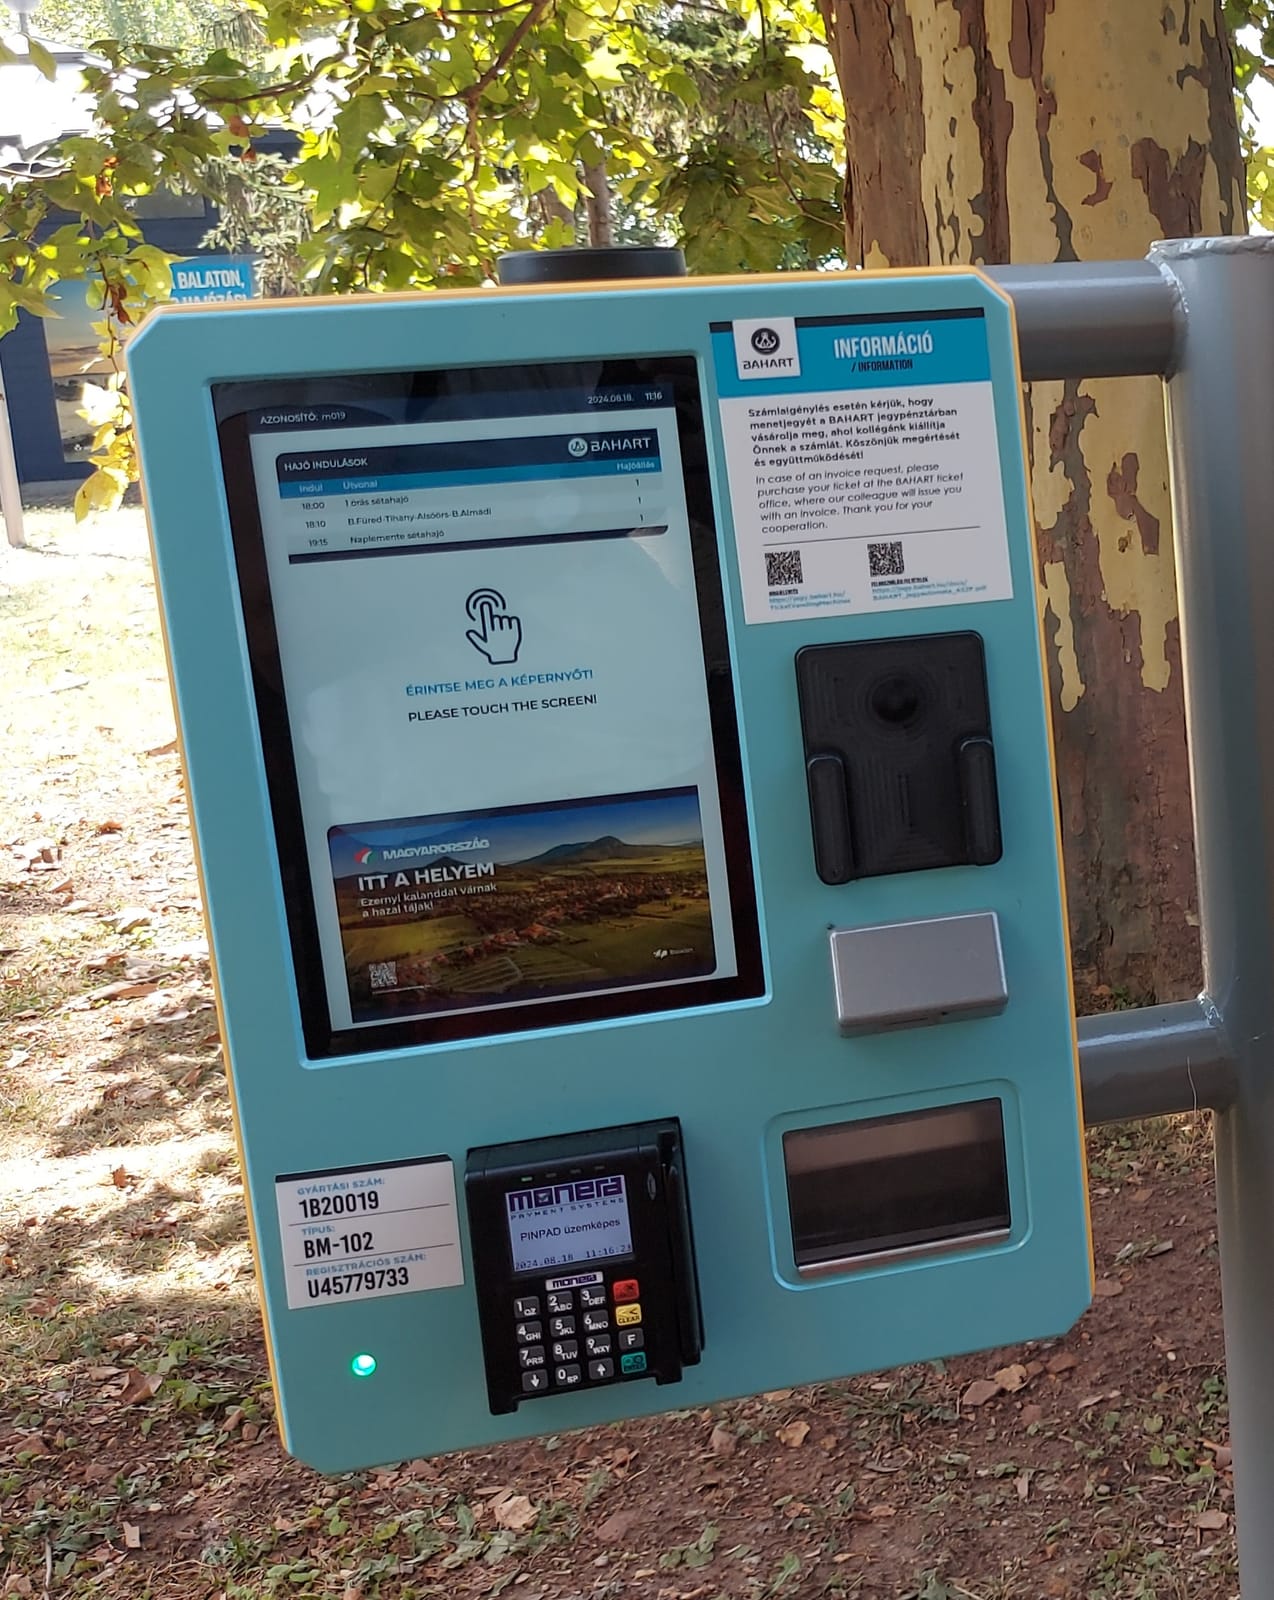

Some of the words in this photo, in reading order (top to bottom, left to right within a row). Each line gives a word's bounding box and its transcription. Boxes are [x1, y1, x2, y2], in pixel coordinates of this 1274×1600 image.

[178, 269, 245, 289] BALATON,
[834, 330, 934, 360] INFORMÁCIÓ
[743, 358, 794, 370] BAHART
[858, 359, 913, 372] INFORMATION
[748, 404, 830, 417] Számlaigénylés
[833, 402, 867, 412] esetén
[870, 399, 905, 410] kérjük,
[908, 397, 934, 407] hogy
[750, 417, 816, 430] menetjegyét
[828, 413, 874, 424] BAHART
[878, 408, 958, 422] jegypénztárban
[751, 431, 798, 442] vásárolja
[802, 431, 828, 439] meg,
[831, 426, 853, 436] ahol
[856, 423, 906, 435] kollégánk
[909, 420, 946, 431] kiállítja
[590, 437, 652, 452] BAHART
[752, 444, 787, 454] Önnek
[800, 441, 842, 451] számlát.
[846, 435, 899, 448] Köszönjük
[902, 432, 960, 444] megértését
[284, 460, 311, 472] HAJÓ
[312, 457, 368, 470] INDULÁSOK
[754, 458, 766, 467] és
[756, 476, 765, 485] In
[768, 475, 792, 483] case
[795, 472, 806, 481] of
[808, 472, 822, 480] an
[824, 469, 861, 479] invoice
[864, 464, 904, 477] request,
[906, 464, 940, 474] please
[299, 482, 323, 493] Indul
[342, 478, 378, 490] Útvonal
[758, 486, 805, 499] purchase
[808, 484, 830, 494] your
[833, 480, 860, 491] ticket
[863, 480, 874, 488] at
[877, 478, 893, 487] the
[896, 474, 934, 486] BAHART
[937, 472, 964, 482] ticket
[759, 499, 791, 509] office,
[794, 497, 825, 506] where
[828, 495, 844, 504] our
[848, 490, 898, 502] colleague
[901, 488, 916, 498] will
[918, 487, 941, 496] issue
[944, 486, 962, 495] you
[760, 511, 781, 521] with
[784, 511, 797, 519] an
[800, 508, 839, 518] invoice.
[843, 503, 872, 515] Thank
[874, 503, 893, 514] you
[896, 501, 909, 510] for
[911, 500, 933, 510] your
[762, 521, 828, 534] cooperation.
[350, 533, 405, 544] Naplemente
[406, 682, 462, 697] ÉRINTSE
[465, 678, 495, 691] MEG
[499, 678, 508, 688] A
[408, 707, 460, 722] PLEASE
[462, 702, 509, 717] TOUCH
[512, 700, 538, 712] THE
[541, 694, 598, 709] SCREEN!
[383, 836, 490, 861] MAGYARORSZÁG
[358, 874, 388, 892] ITT
[394, 872, 410, 888] A
[414, 862, 495, 885] HELYEM
[404, 885, 458, 902] kalanddal
[460, 882, 498, 895] várnak
[362, 910, 369, 918] a
[372, 905, 401, 917] hazai
[404, 901, 434, 914] tájak!
[297, 1182, 349, 1195] GYÁRTÁSI
[352, 1177, 385, 1189] SZÁM:
[299, 1190, 379, 1218] 1B20019
[511, 1207, 564, 1221] PAYMENT
[571, 1198, 624, 1211] SYSTEMS
[301, 1225, 335, 1236] TÍPUS:
[520, 1227, 561, 1242] PINPAD
[564, 1218, 620, 1234] üzemképes
[304, 1232, 374, 1259] BM-102
[306, 1257, 391, 1276] REGISZTRÁCIÓS
[394, 1253, 427, 1264] SZÁM:
[308, 1267, 409, 1299] U45779733
[517, 1301, 523, 1312] 1
[549, 1295, 558, 1306] 2
[554, 1303, 573, 1312] ABC
[582, 1290, 590, 1300] 3
[588, 1296, 606, 1306] DEF
[555, 1319, 563, 1330] 5
[560, 1326, 575, 1335] JKL
[584, 1315, 592, 1325] 6
[588, 1321, 608, 1331] MNO
[618, 1315, 640, 1324] CLEAR
[518, 1326, 527, 1335] 4
[525, 1332, 541, 1341] GHI
[627, 1334, 636, 1345] F
[555, 1344, 563, 1355] 8
[562, 1351, 578, 1360] TUV
[588, 1339, 595, 1349] 9
[522, 1350, 529, 1361] 7
[526, 1356, 544, 1366] PRS
[558, 1369, 566, 1379] 0
